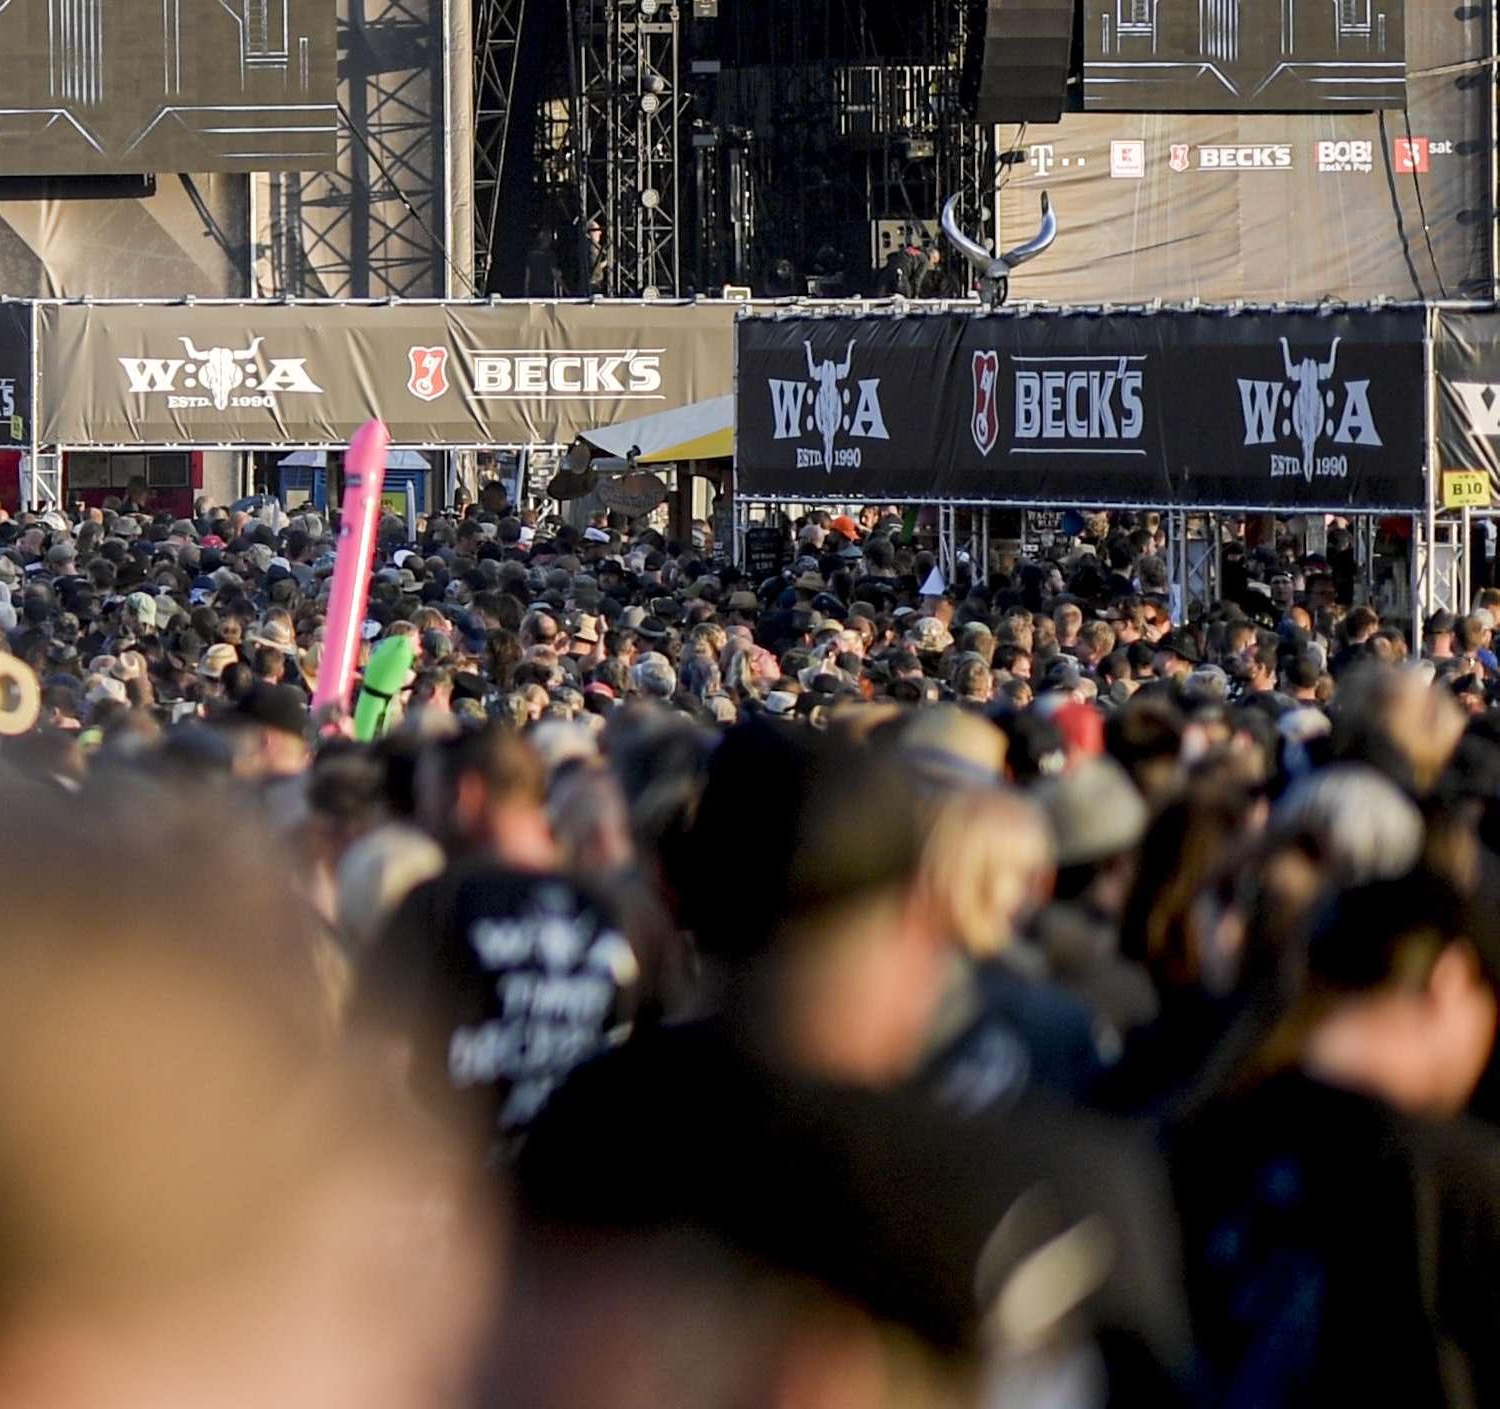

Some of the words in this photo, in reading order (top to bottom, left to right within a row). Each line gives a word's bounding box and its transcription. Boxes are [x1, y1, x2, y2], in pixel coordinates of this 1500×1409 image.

[1200, 146, 1291, 167] BECK'S
[1319, 141, 1372, 164] BOB!
[474, 351, 661, 392] BECK'S
[167, 396, 212, 408] ESTD.
[230, 397, 274, 408] 1990
[1015, 357, 1143, 438] BECK'S
[797, 448, 823, 468] ESTD.
[834, 448, 861, 467] 1990
[1271, 455, 1302, 476] ESTD.
[1316, 455, 1347, 477] 1990
[1453, 484, 1463, 495] B
[1467, 483, 1482, 494] 10
